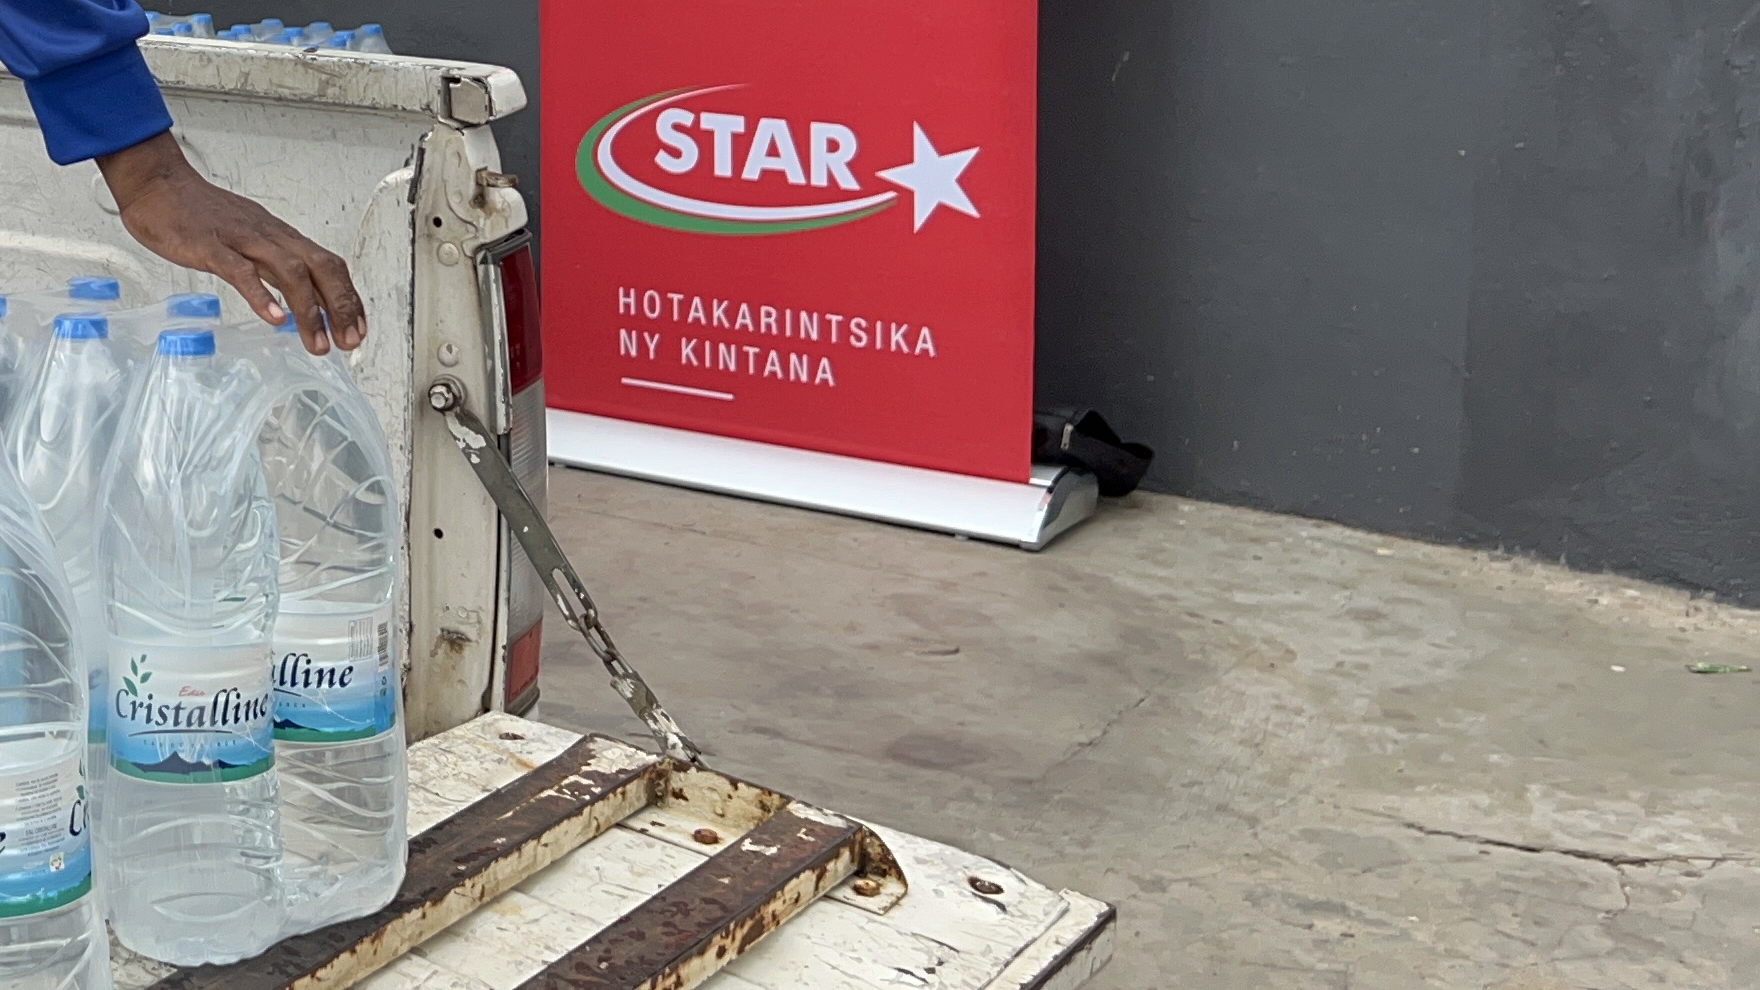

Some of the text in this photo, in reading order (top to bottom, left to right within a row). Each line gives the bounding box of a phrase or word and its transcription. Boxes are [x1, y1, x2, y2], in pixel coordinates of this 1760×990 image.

[654, 108, 860, 191] STAR
[618, 286, 937, 358] HOTAKARINTSIKA
[619, 328, 836, 387] NY KINTANA
[115, 687, 268, 727] Cristalline
